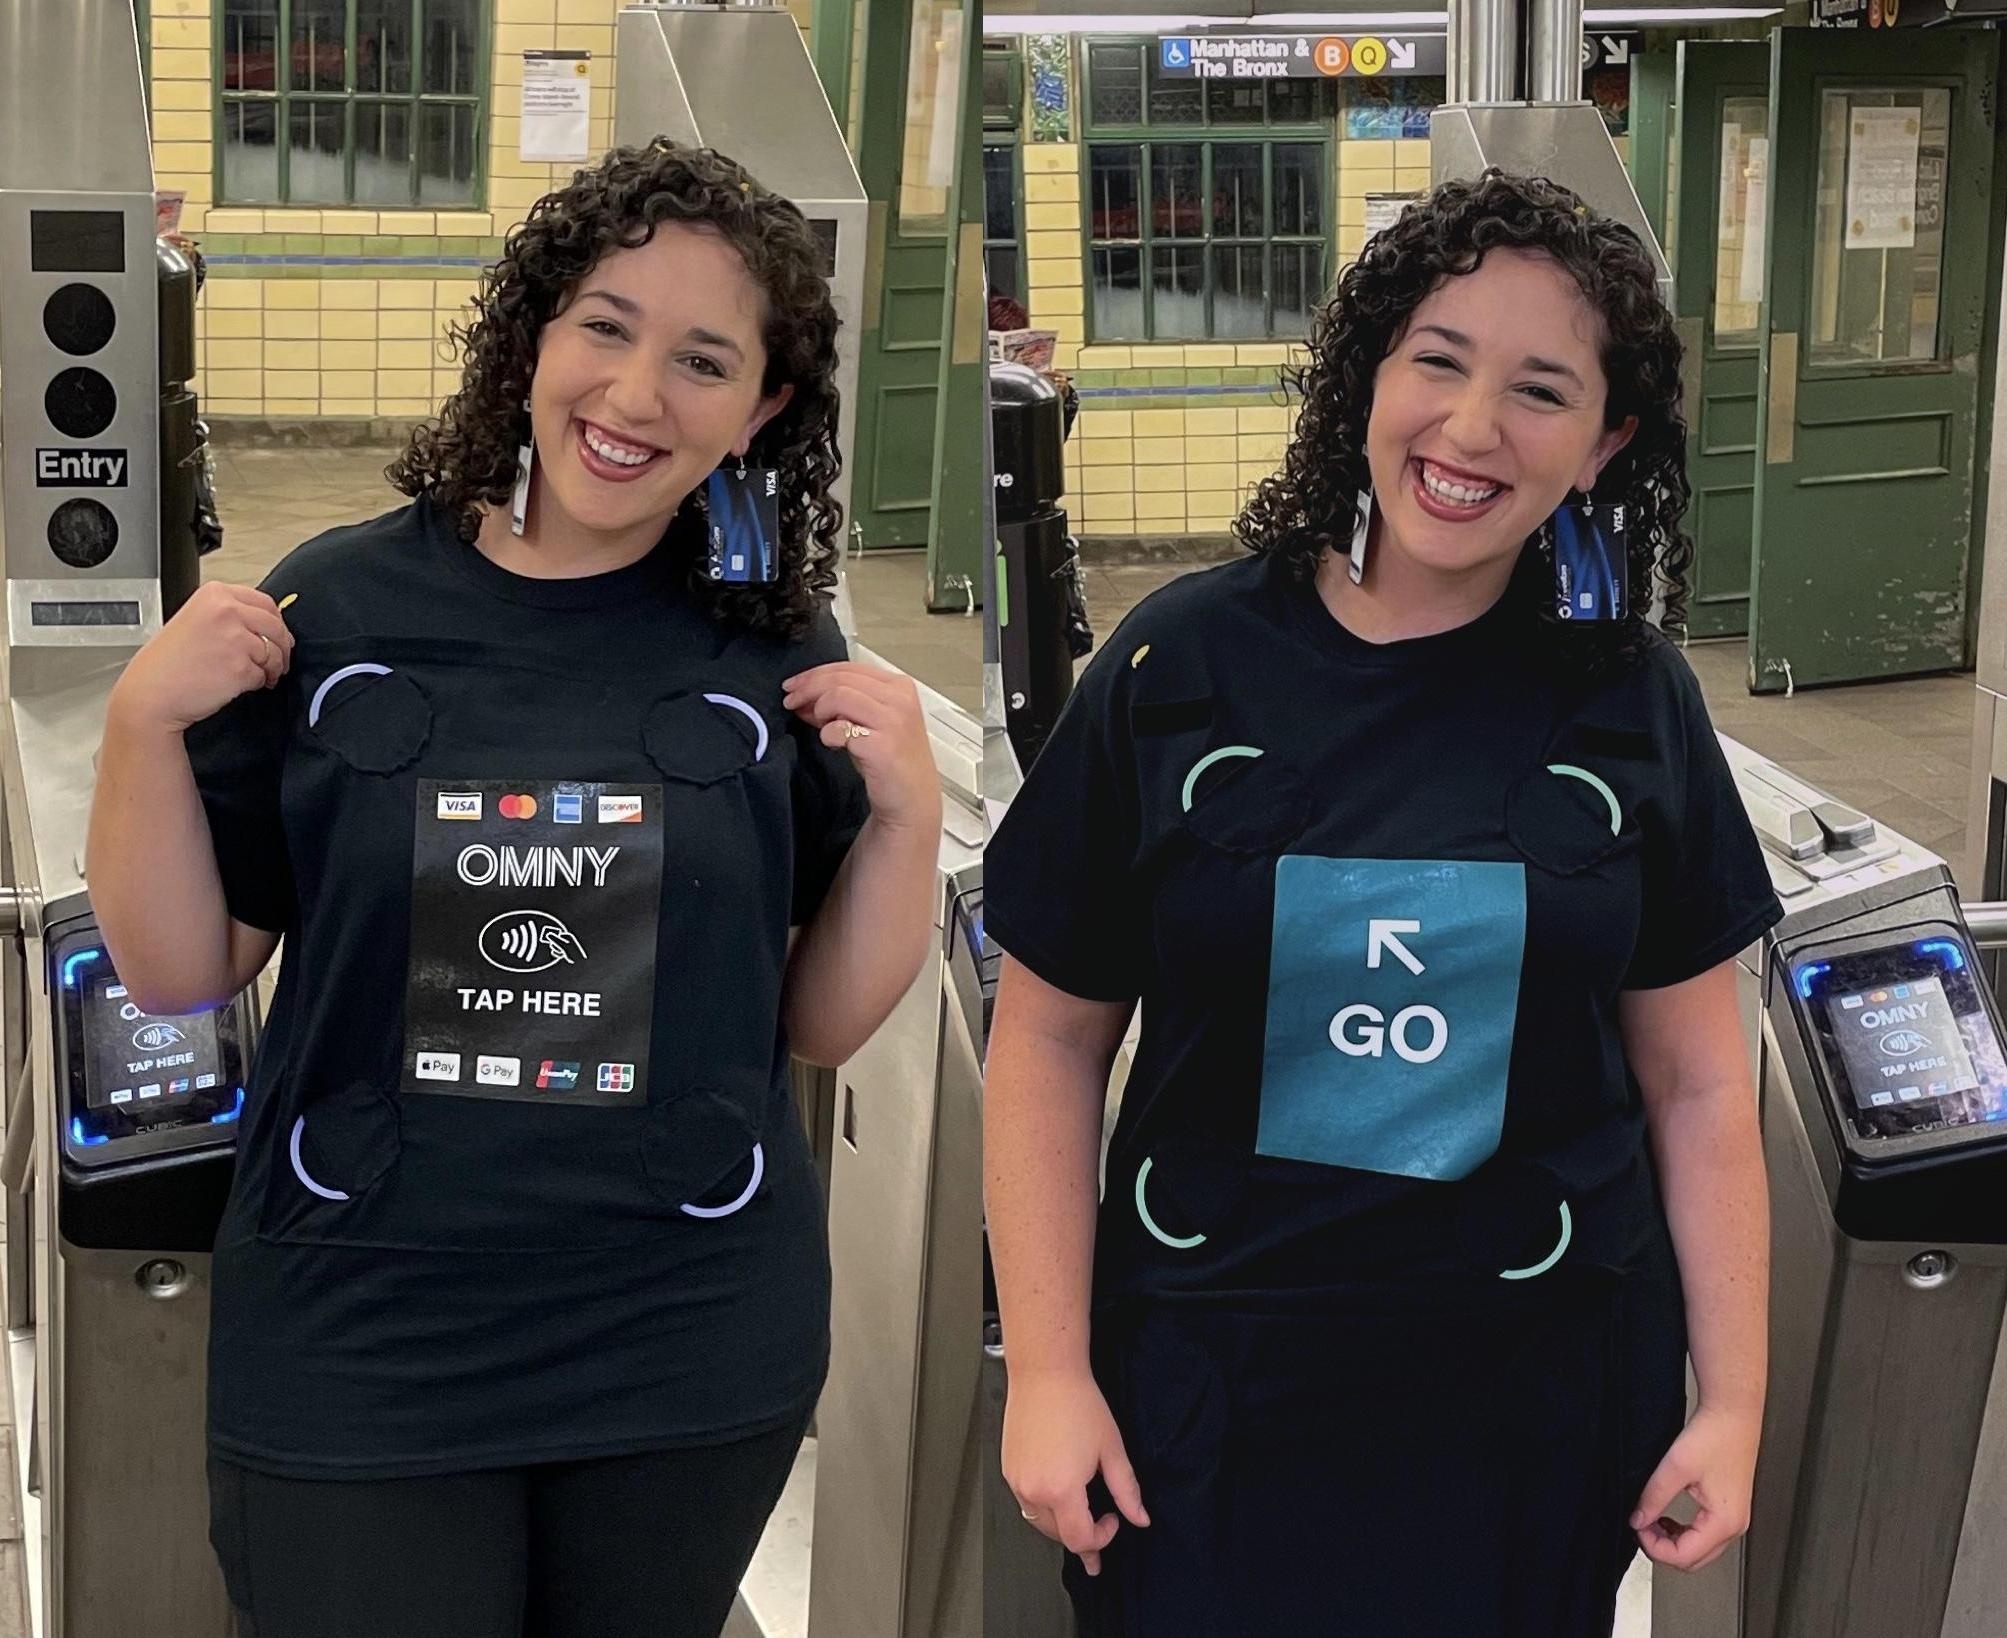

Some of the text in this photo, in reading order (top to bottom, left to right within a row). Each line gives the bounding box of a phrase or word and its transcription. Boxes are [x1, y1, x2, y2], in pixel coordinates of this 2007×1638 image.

[1190, 38, 1310, 58] Manhattan &
[1324, 45, 1377, 67] B Q
[1190, 58, 1289, 77] The Bronx
[38, 450, 125, 486] Entry
[765, 471, 777, 497] VISA
[1613, 506, 1624, 534] VISA
[445, 800, 476, 812] VISA
[456, 843, 621, 887] OMNY
[457, 988, 601, 1017] TAP HERE
[1860, 1002, 1929, 1028] OMNY
[1328, 1003, 1449, 1064] GO
[127, 1052, 195, 1074] TAP HERE
[432, 1060, 456, 1074] Pay
[493, 1065, 515, 1079] Pay
[1880, 1056, 1947, 1078] TAP HERE
